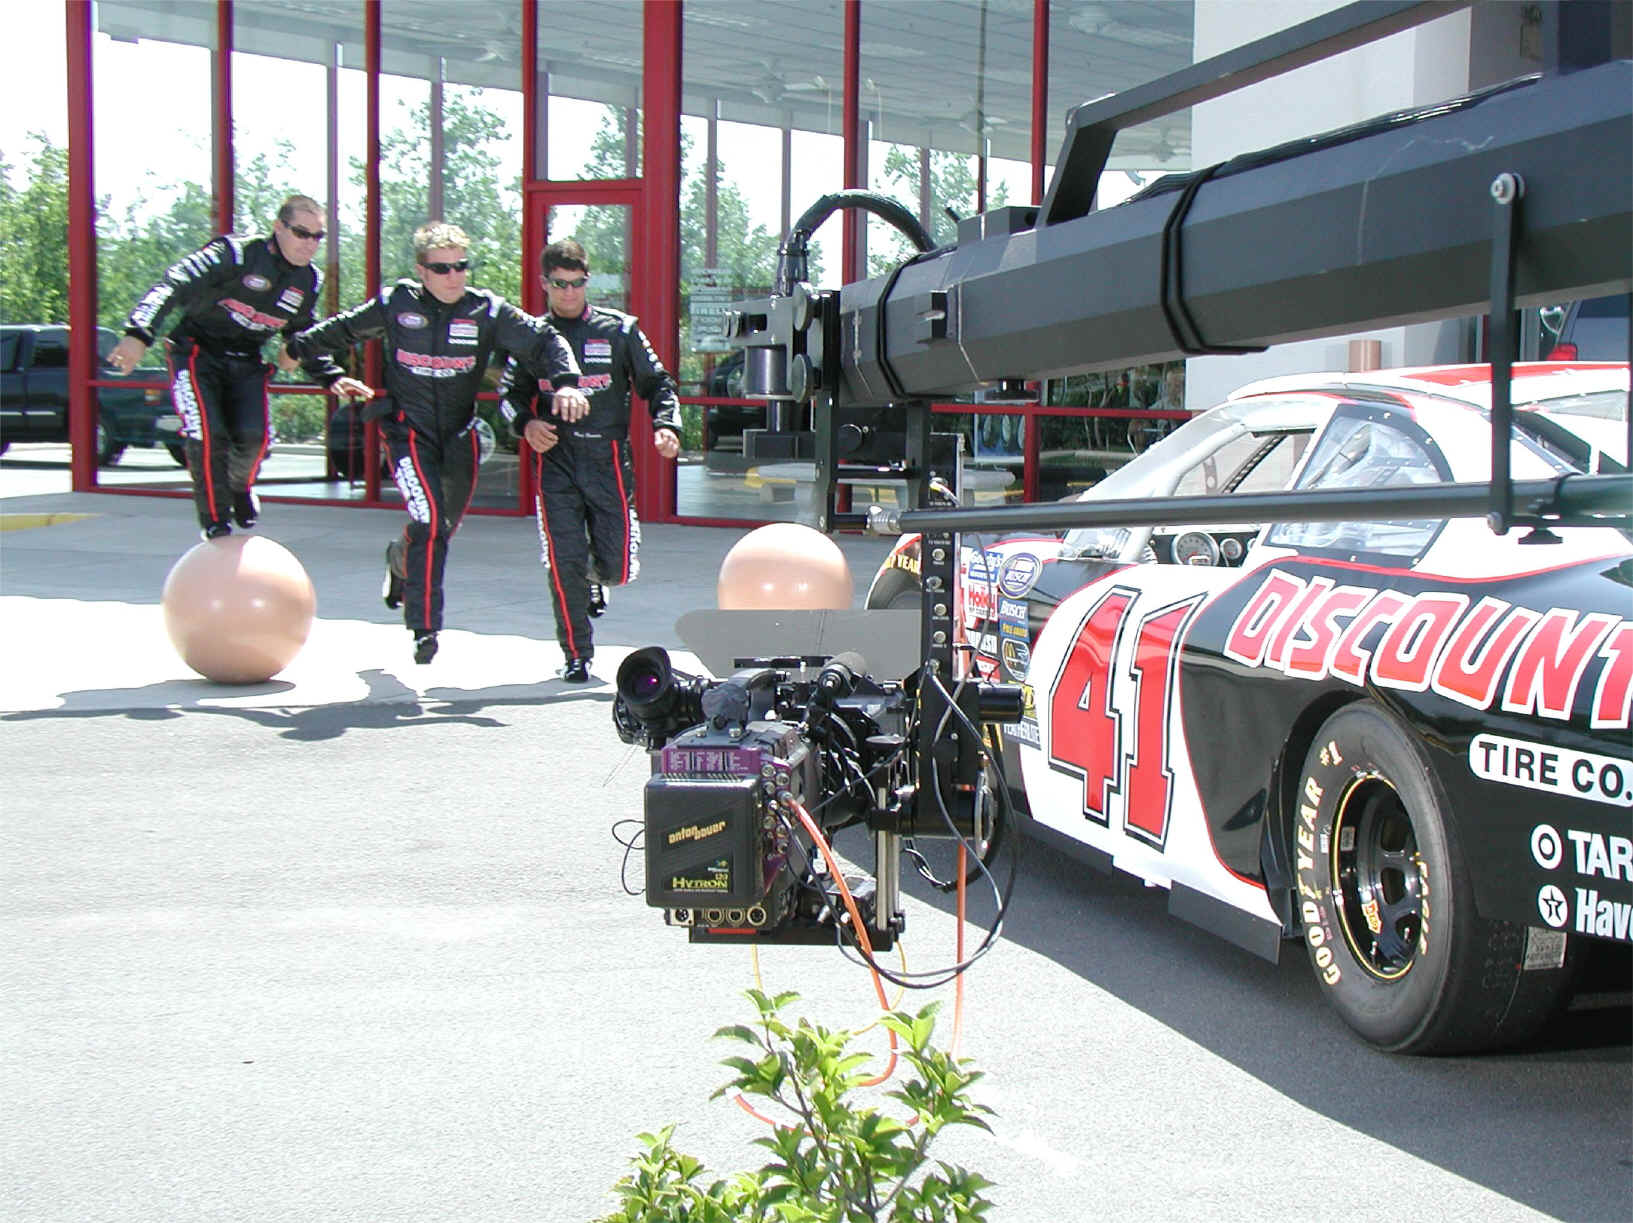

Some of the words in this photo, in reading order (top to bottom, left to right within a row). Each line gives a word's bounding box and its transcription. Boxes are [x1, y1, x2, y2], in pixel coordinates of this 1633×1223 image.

[1000, 600, 1027, 619] BUSCH
[1223, 568, 1633, 729] DISCOUNT
[1048, 584, 1208, 854] 41
[1319, 741, 1344, 767] #1
[1479, 741, 1559, 786] TIRE
[1571, 758, 1632, 799] CO.
[1567, 829, 1633, 882] TAR
